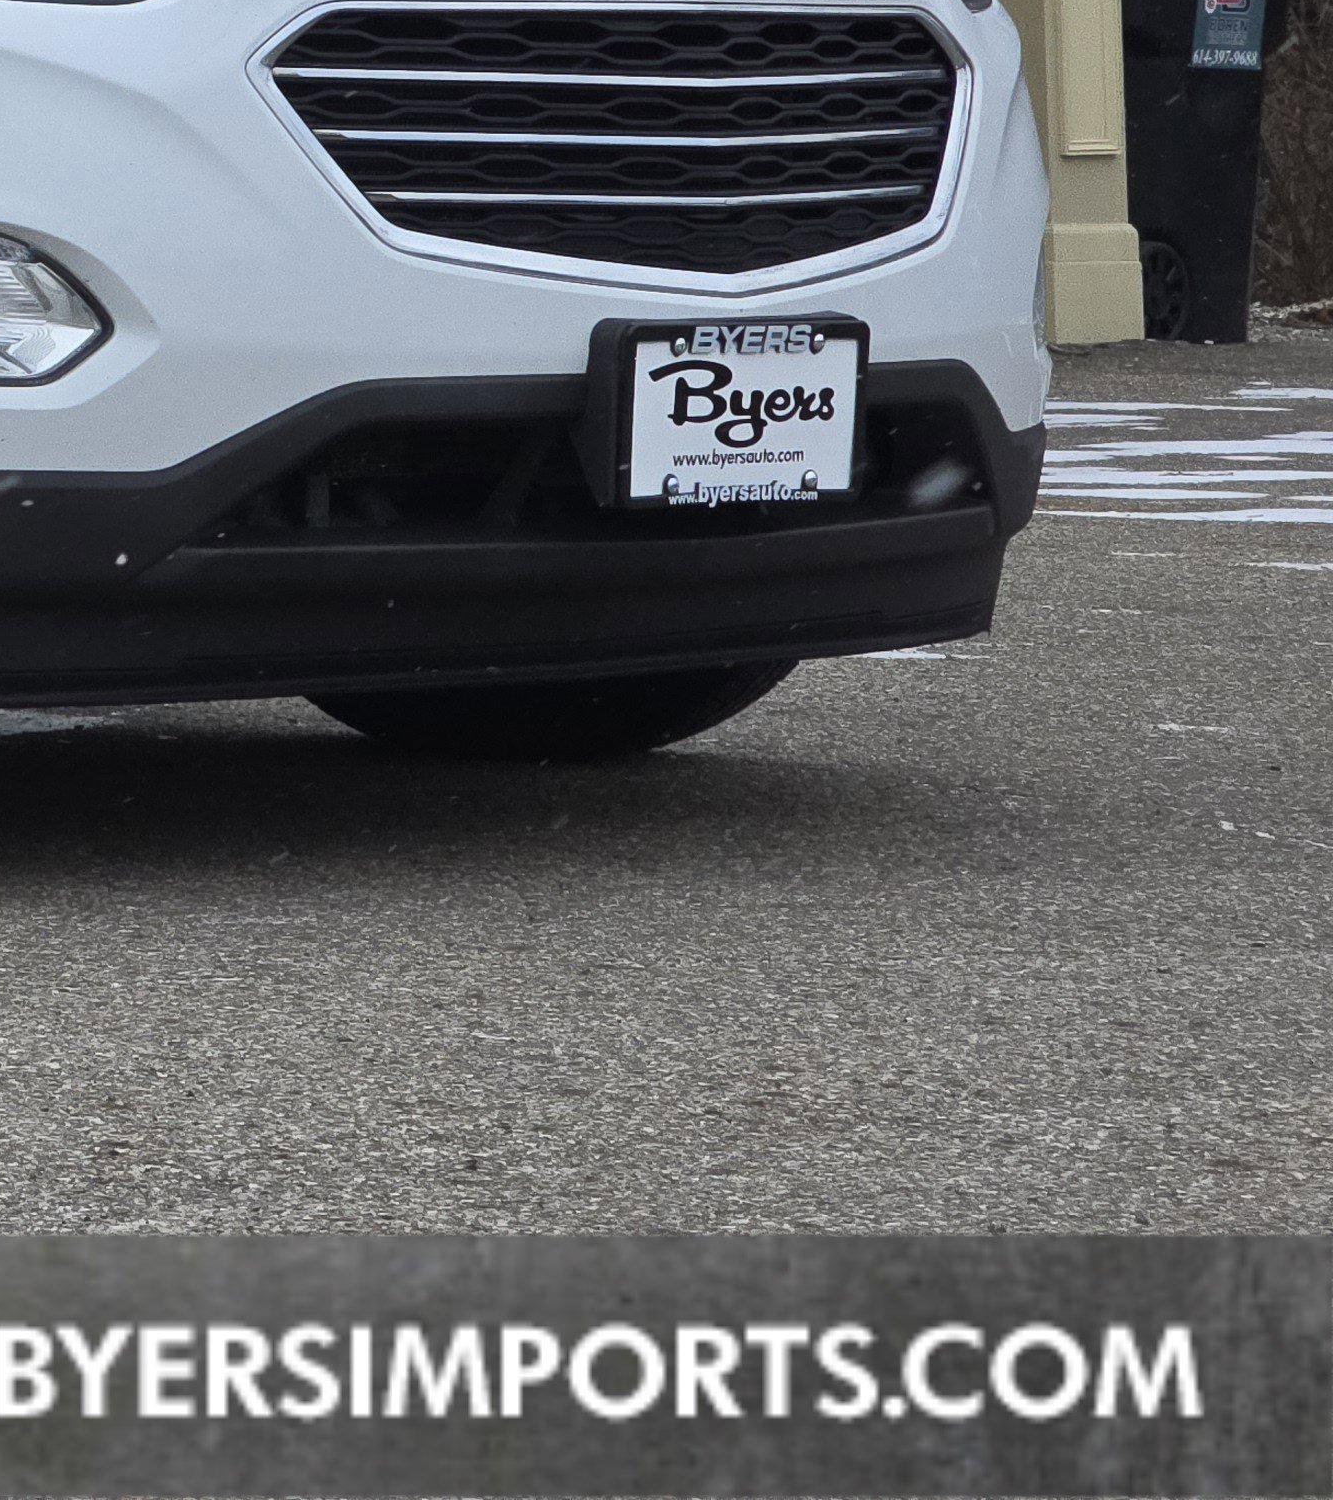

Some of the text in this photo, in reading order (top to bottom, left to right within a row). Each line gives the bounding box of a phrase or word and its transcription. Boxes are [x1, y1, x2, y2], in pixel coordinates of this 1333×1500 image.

[689, 324, 813, 354] BYERS
[648, 359, 835, 449] Byers
[672, 448, 805, 470] www.byersauto.com
[668, 480, 819, 509] www.byersauto.com
